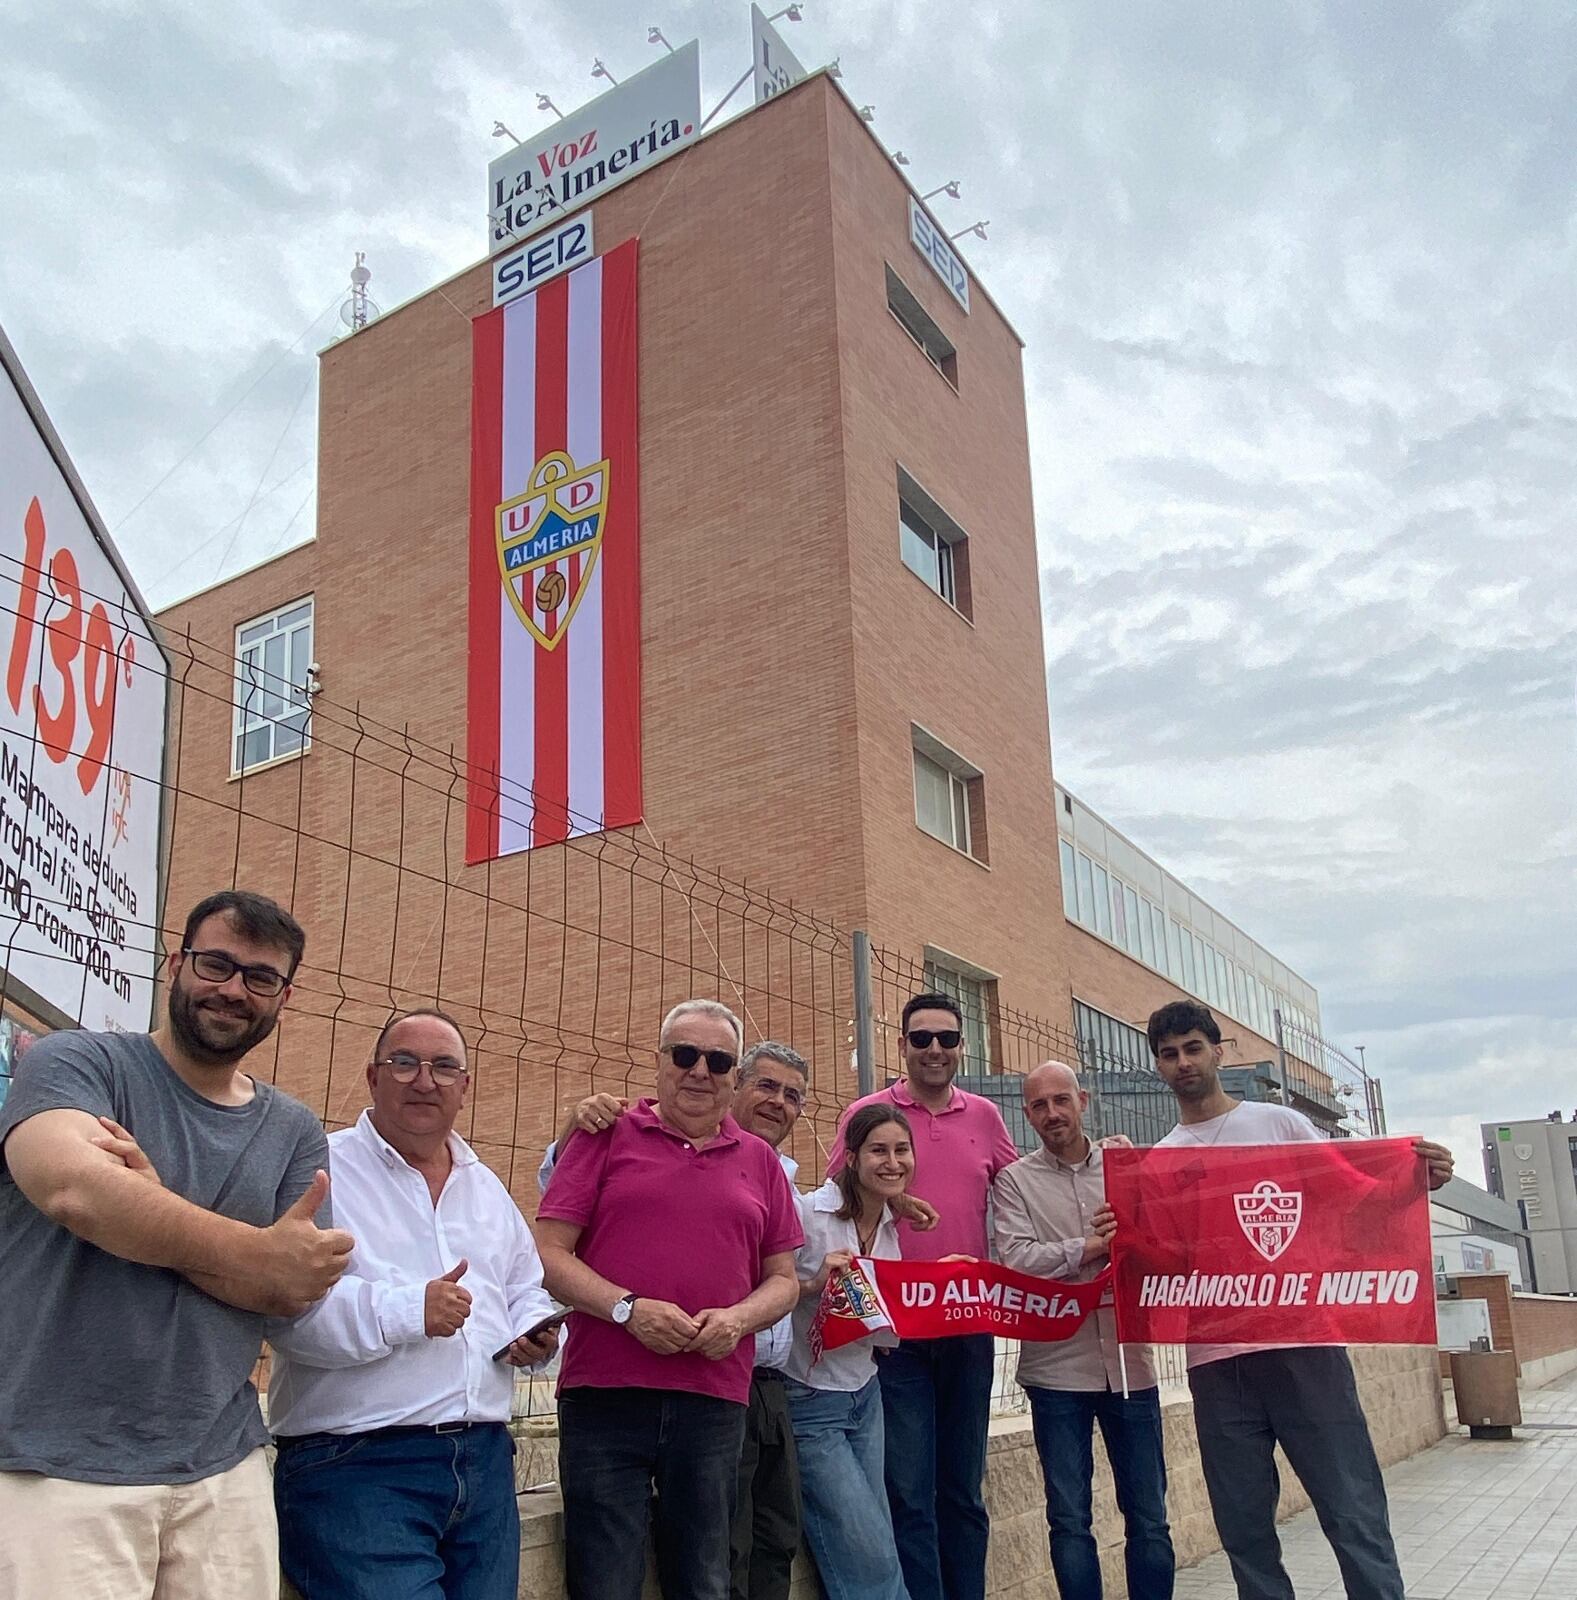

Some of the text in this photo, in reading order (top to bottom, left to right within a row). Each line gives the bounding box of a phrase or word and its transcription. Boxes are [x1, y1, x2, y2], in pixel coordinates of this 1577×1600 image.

[495, 128, 598, 208] La Voz
[498, 223, 588, 298] SER
[914, 210, 967, 305] SER
[509, 482, 595, 532] U D
[510, 520, 594, 568] ALMERIA
[7, 495, 116, 796] 139
[2, 741, 138, 917] Mampara de ducha
[0, 796, 126, 951] frontal fija Caribe
[35, 902, 83, 963] cromo
[86, 937, 112, 986] 100
[114, 968, 132, 1004] cm
[1245, 1213, 1296, 1224] ALMERIA
[900, 1278, 1082, 1320] UD ALMERÍA
[1138, 1268, 1420, 1307] HAGÁMOSLO DE NUEVO
